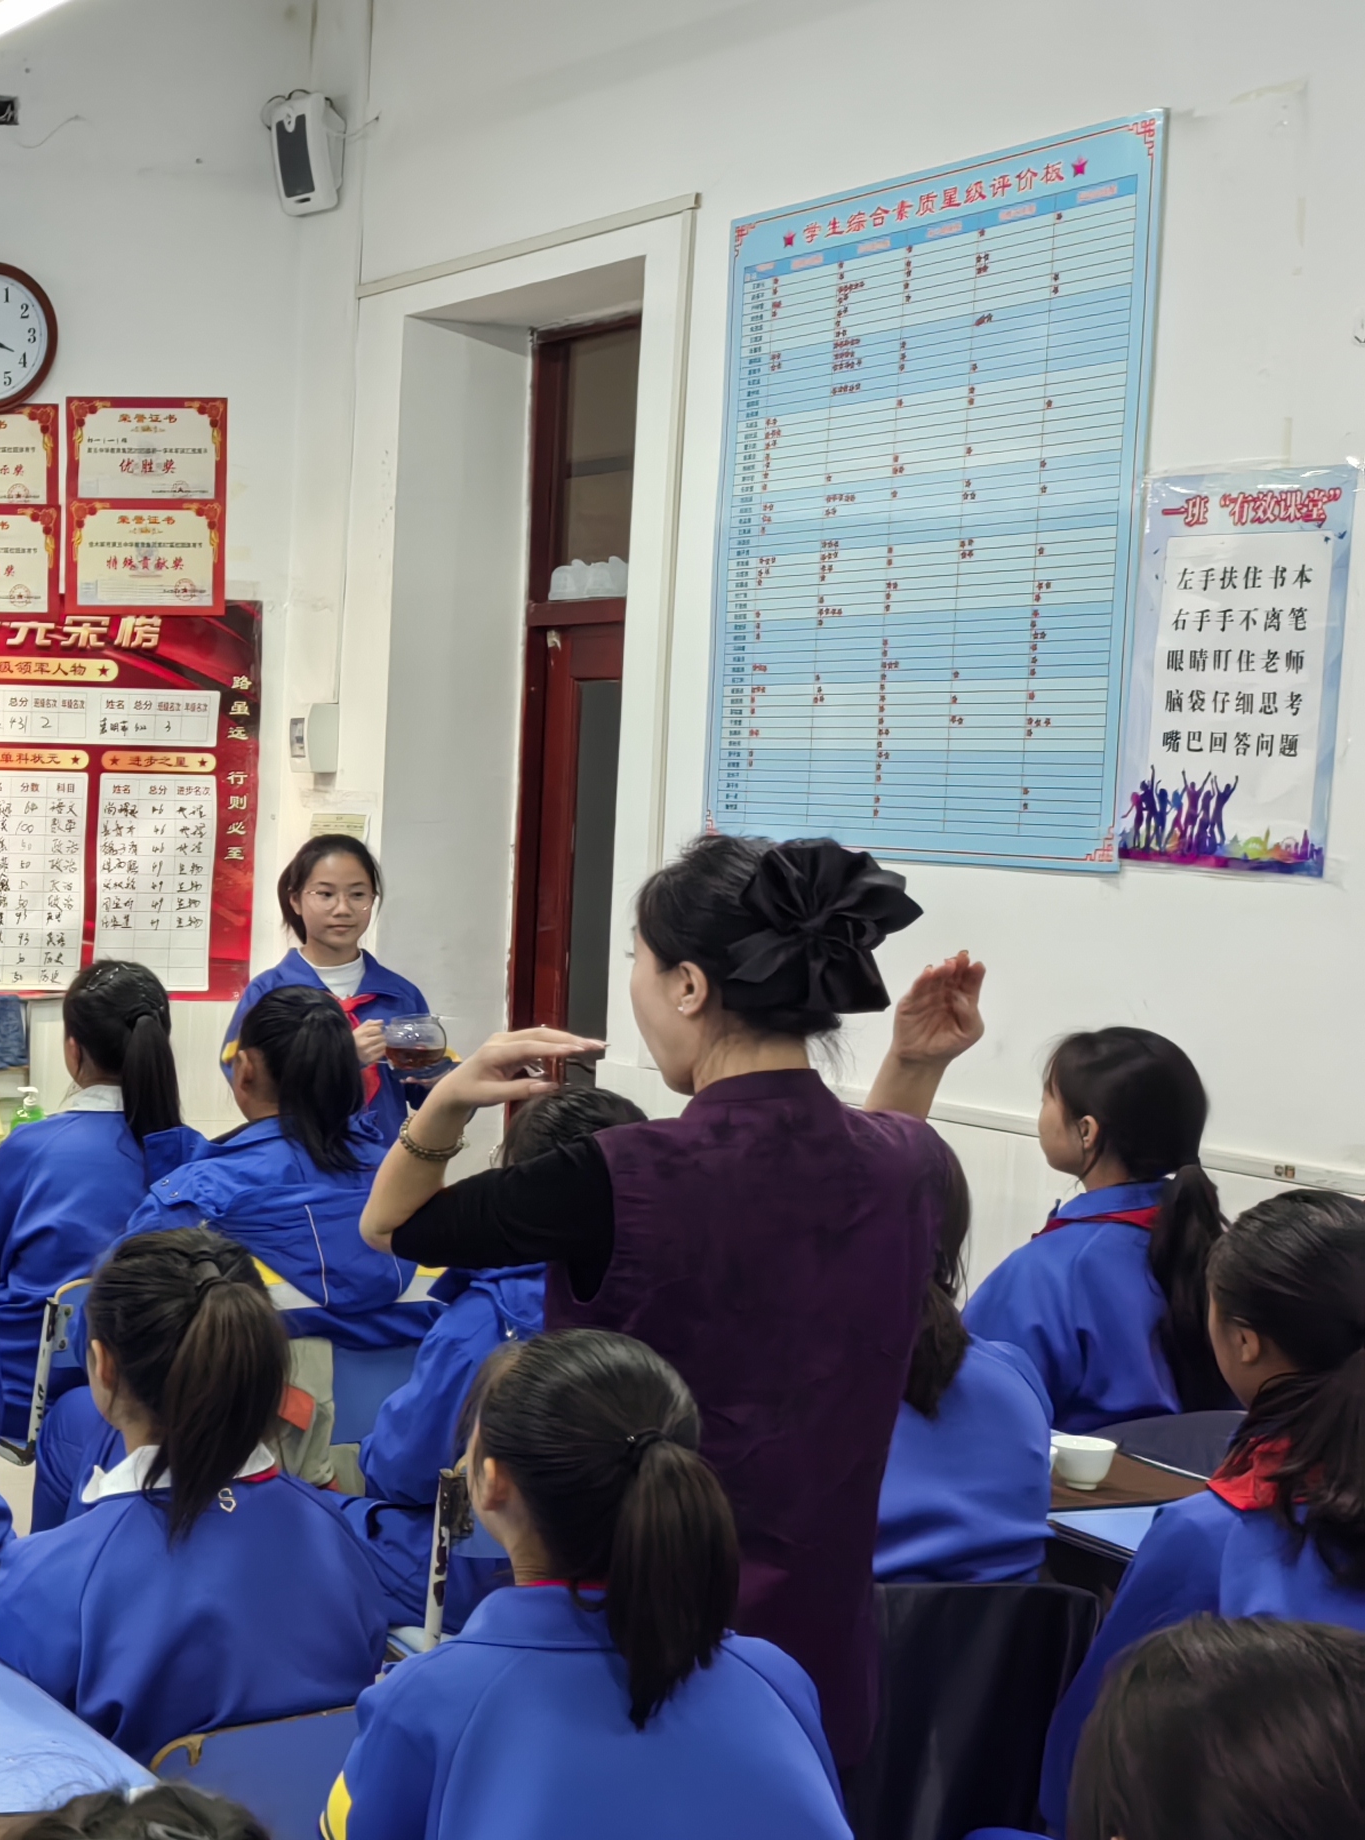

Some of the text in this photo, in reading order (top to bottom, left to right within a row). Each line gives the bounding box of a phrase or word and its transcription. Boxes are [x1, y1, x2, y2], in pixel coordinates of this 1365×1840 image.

[802, 161, 1066, 244] 学生综合素质星级评价板
[4, 287, 10, 303] 1
[20, 303, 29, 319] 2
[27, 328, 36, 343] 3
[18, 352, 27, 368] 4
[3, 371, 12, 386] 5
[118, 413, 177, 423] 荣誉证书
[119, 458, 176, 474] 优胜奖
[1161, 495, 1209, 527] 一班
[117, 515, 175, 525] 荣誉证书
[107, 556, 184, 570] 特殊贡献奖
[1176, 565, 1314, 592] 左手扶住书本
[1171, 607, 1309, 633] 右手手不离笔
[8, 696, 28, 707] 总分
[105, 699, 125, 710] 姓名
[133, 700, 153, 711] 总分
[1164, 689, 1304, 718] 脑袋仔细思考
[40, 717, 53, 729] 2
[1161, 730, 1300, 758] 嘴巴回答问题
[0, 752, 61, 766] 单科状元
[128, 756, 189, 768] 进步之星
[223, 675, 252, 861] 路虽远 行则必至
[20, 782, 40, 793] 分数
[56, 783, 75, 793] 科目
[112, 785, 131, 794] 姓名
[148, 785, 168, 795] 总分
[177, 786, 211, 796] 进步名次
